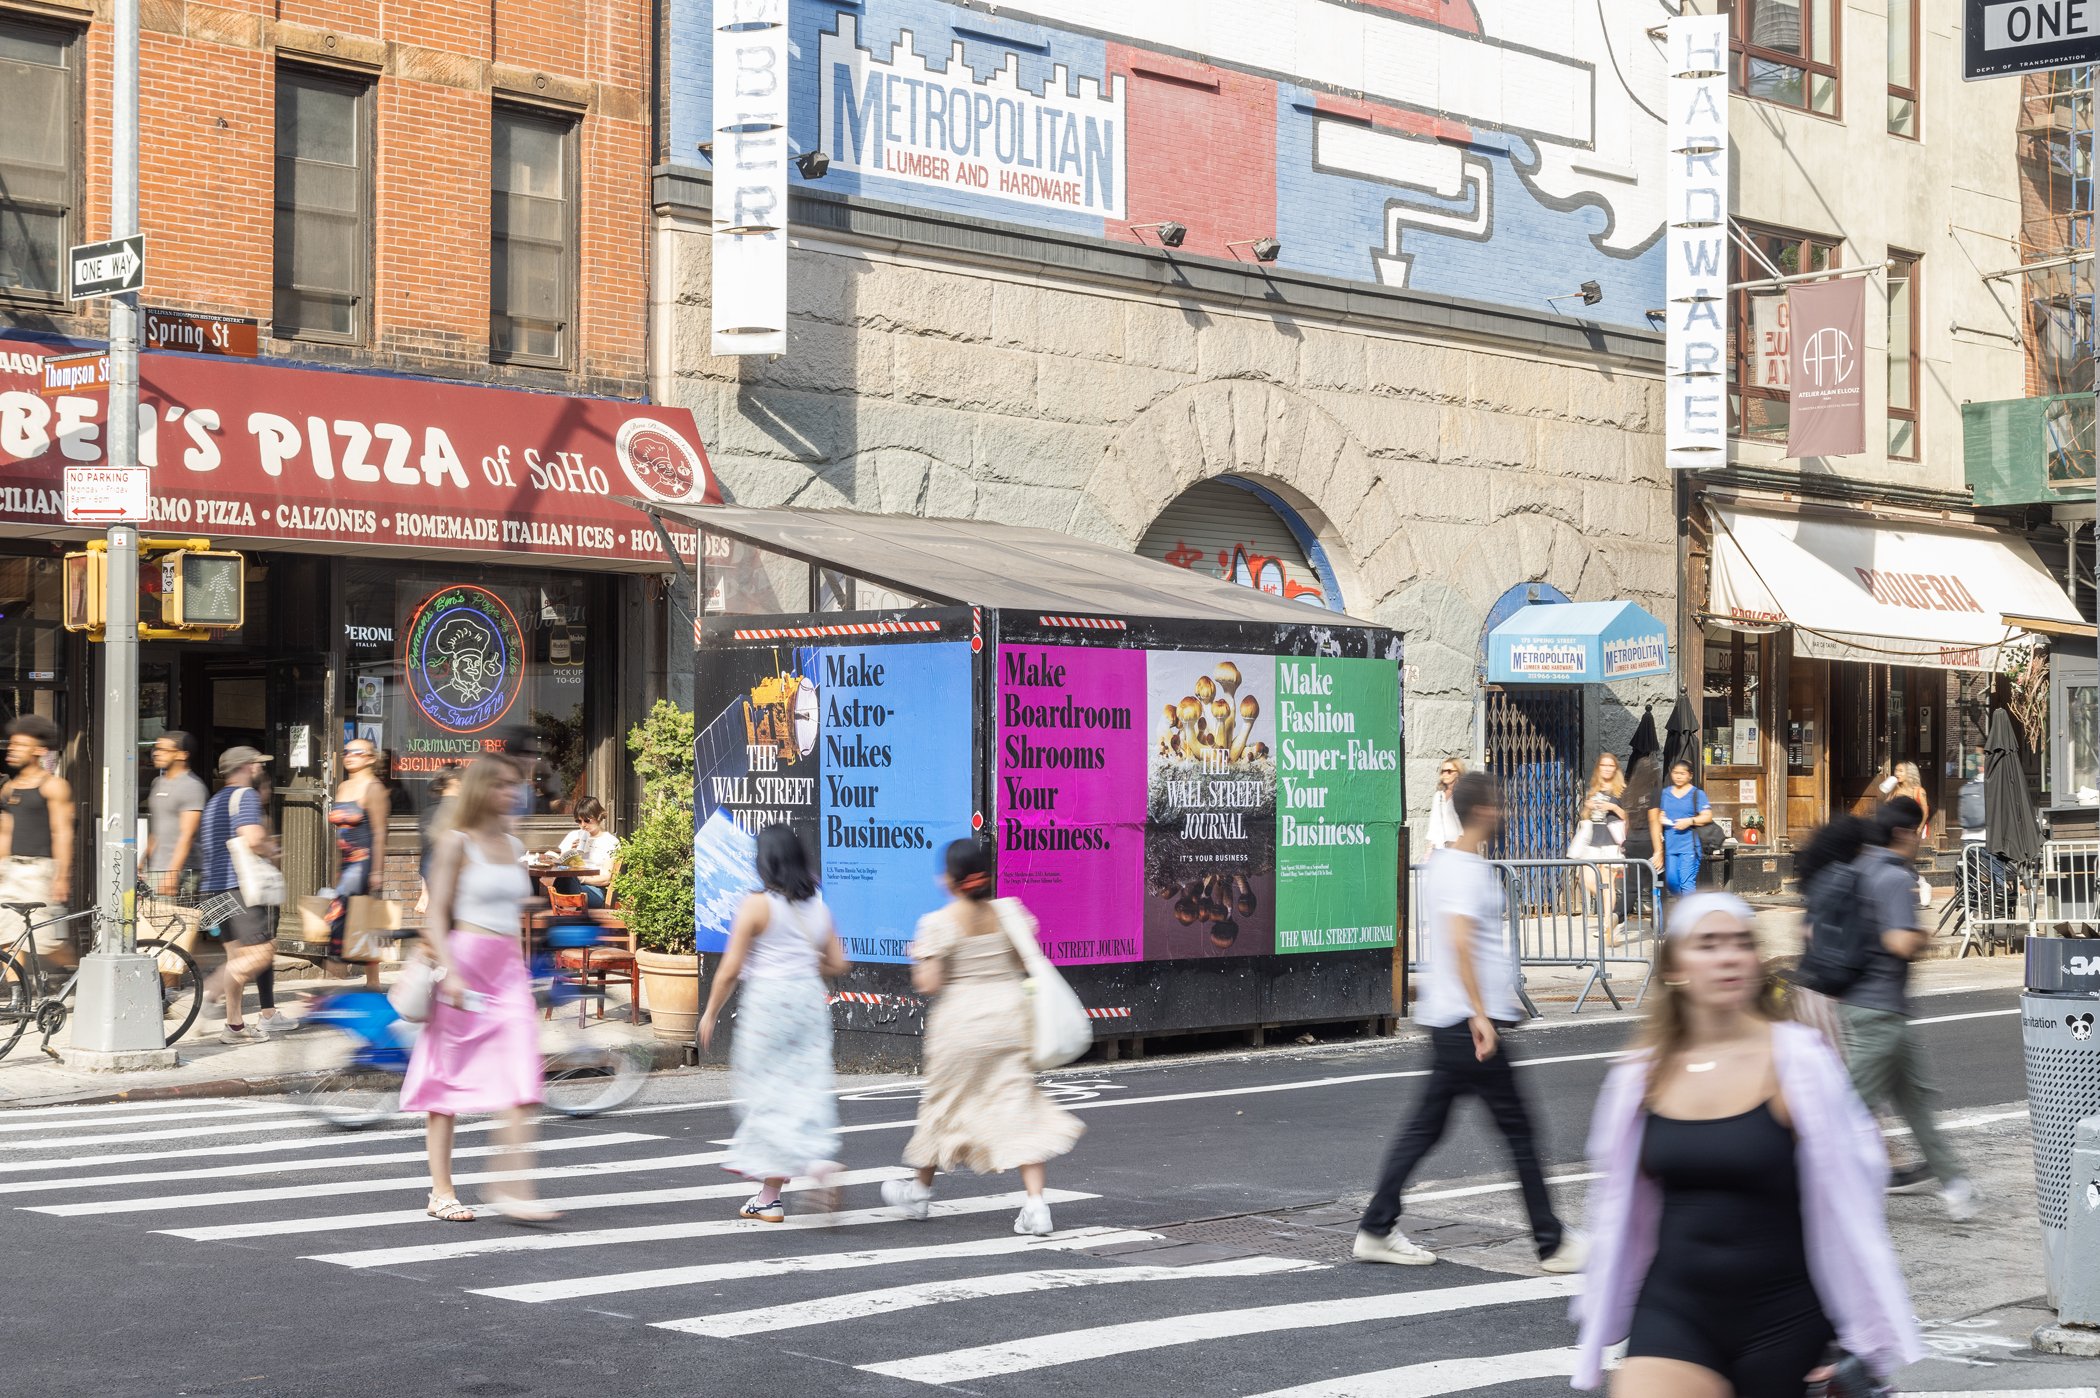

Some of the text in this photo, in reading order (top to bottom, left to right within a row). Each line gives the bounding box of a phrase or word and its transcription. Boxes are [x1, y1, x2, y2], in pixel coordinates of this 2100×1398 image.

[2007, 0, 2088, 42] ONE
[2019, 54, 2086, 67] TRANSPORTATION
[833, 62, 1113, 211] METROPOLITAN
[887, 149, 1081, 205] LUMBER AND HARDWARE
[1683, 32, 1723, 435] HARDWARE
[82, 253, 133, 281] ONE WAY
[148, 316, 229, 352] Spring St
[222, 316, 245, 324] DISTRICT
[45, 357, 110, 391] Thompson St
[1837, 387, 1860, 395] ELLOUZ
[248, 412, 470, 489] PIZZA
[482, 445, 517, 488] of
[524, 448, 610, 496] SoHo
[71, 472, 129, 482] NO PARKING
[195, 500, 256, 527] PIZZA
[276, 504, 376, 533] CALZONES
[395, 512, 614, 550] HOMEMADE ITALIAN ICES
[631, 529, 663, 552] HOT
[1854, 567, 1985, 613] BOQUERIA
[826, 653, 885, 688] Make
[1005, 652, 1066, 687] Make
[1513, 652, 1583, 670] METROPOLITAN
[1606, 644, 1664, 673] METROPOLITAN
[1615, 664, 1629, 672] LUMBER
[1638, 660, 1657, 668] HARDWARE
[1940, 646, 1980, 667] BOQUERIA
[1280, 663, 1333, 695] Make
[826, 694, 894, 728] Astro-
[1005, 693, 1132, 730] Boardroom
[1281, 701, 1355, 733] Fashion
[408, 739, 480, 753] NOMINATED
[746, 744, 778, 772] THE
[826, 734, 892, 768] Nukes
[1005, 734, 1105, 769] Shrooms
[1200, 748, 1230, 775] THE
[1282, 738, 1397, 779] Super-Fakes
[711, 776, 814, 805] WALL STREET
[826, 775, 879, 808] Your
[1004, 776, 1059, 810] Your
[1166, 780, 1264, 808] WALL STREET
[1282, 777, 1328, 809] Your
[827, 814, 933, 850] Business.
[1005, 818, 1110, 851] Business.
[1180, 812, 1248, 840] JOURNAL.
[1282, 815, 1371, 847] Business.
[1215, 854, 1248, 862] BUSINESS
[851, 937, 878, 956] WALL
[1057, 940, 1096, 959] STREET
[1096, 938, 1139, 956] JOURNAL.
[1280, 925, 1394, 948] THE WALL STREET JOURNAL
